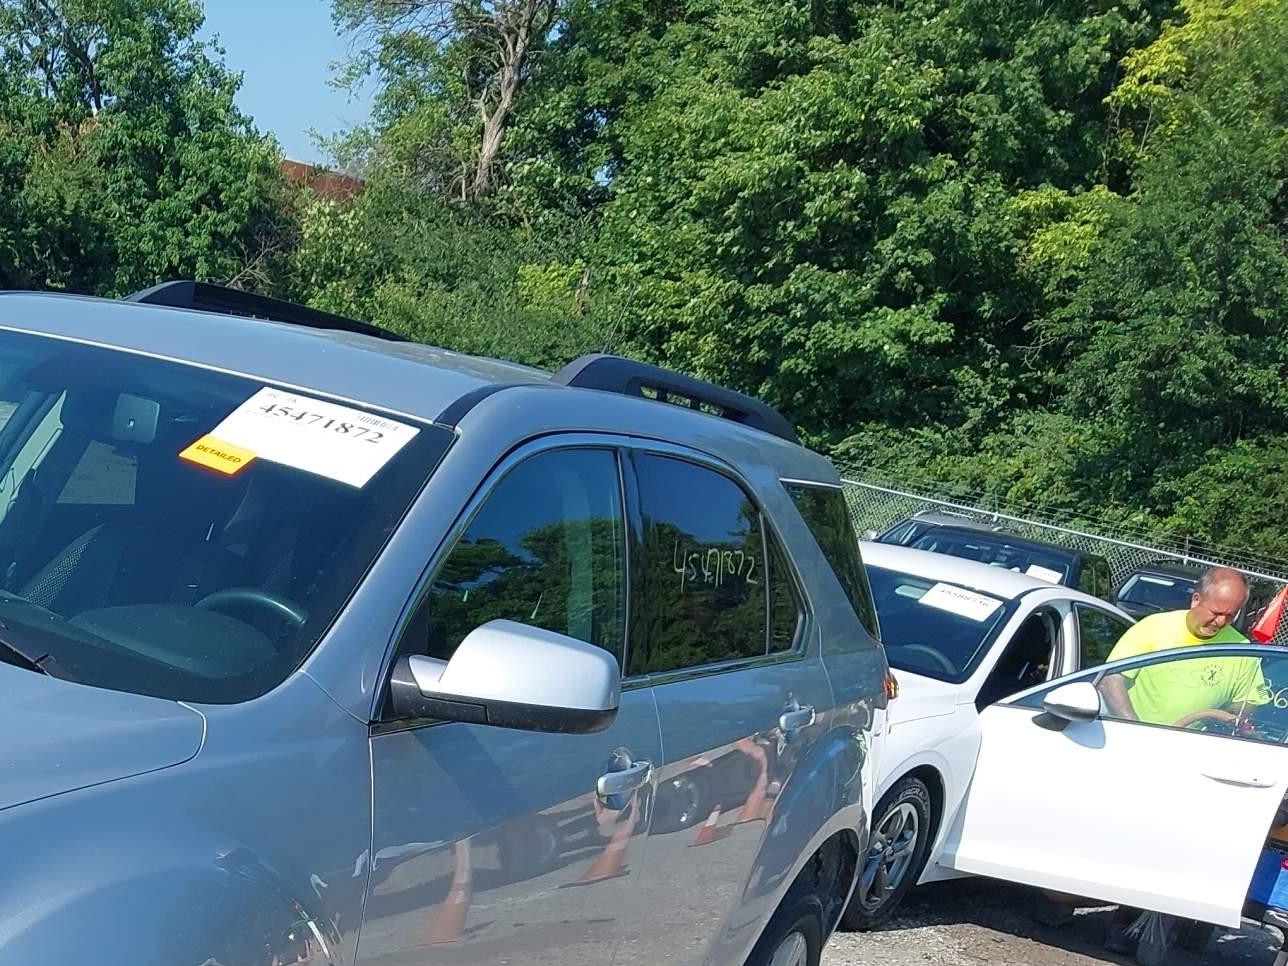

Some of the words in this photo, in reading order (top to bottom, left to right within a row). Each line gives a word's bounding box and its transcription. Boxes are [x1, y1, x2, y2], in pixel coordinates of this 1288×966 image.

[260, 404, 385, 444] 45471872
[196, 445, 241, 463] DETAILED
[674, 540, 758, 593] 45471872
